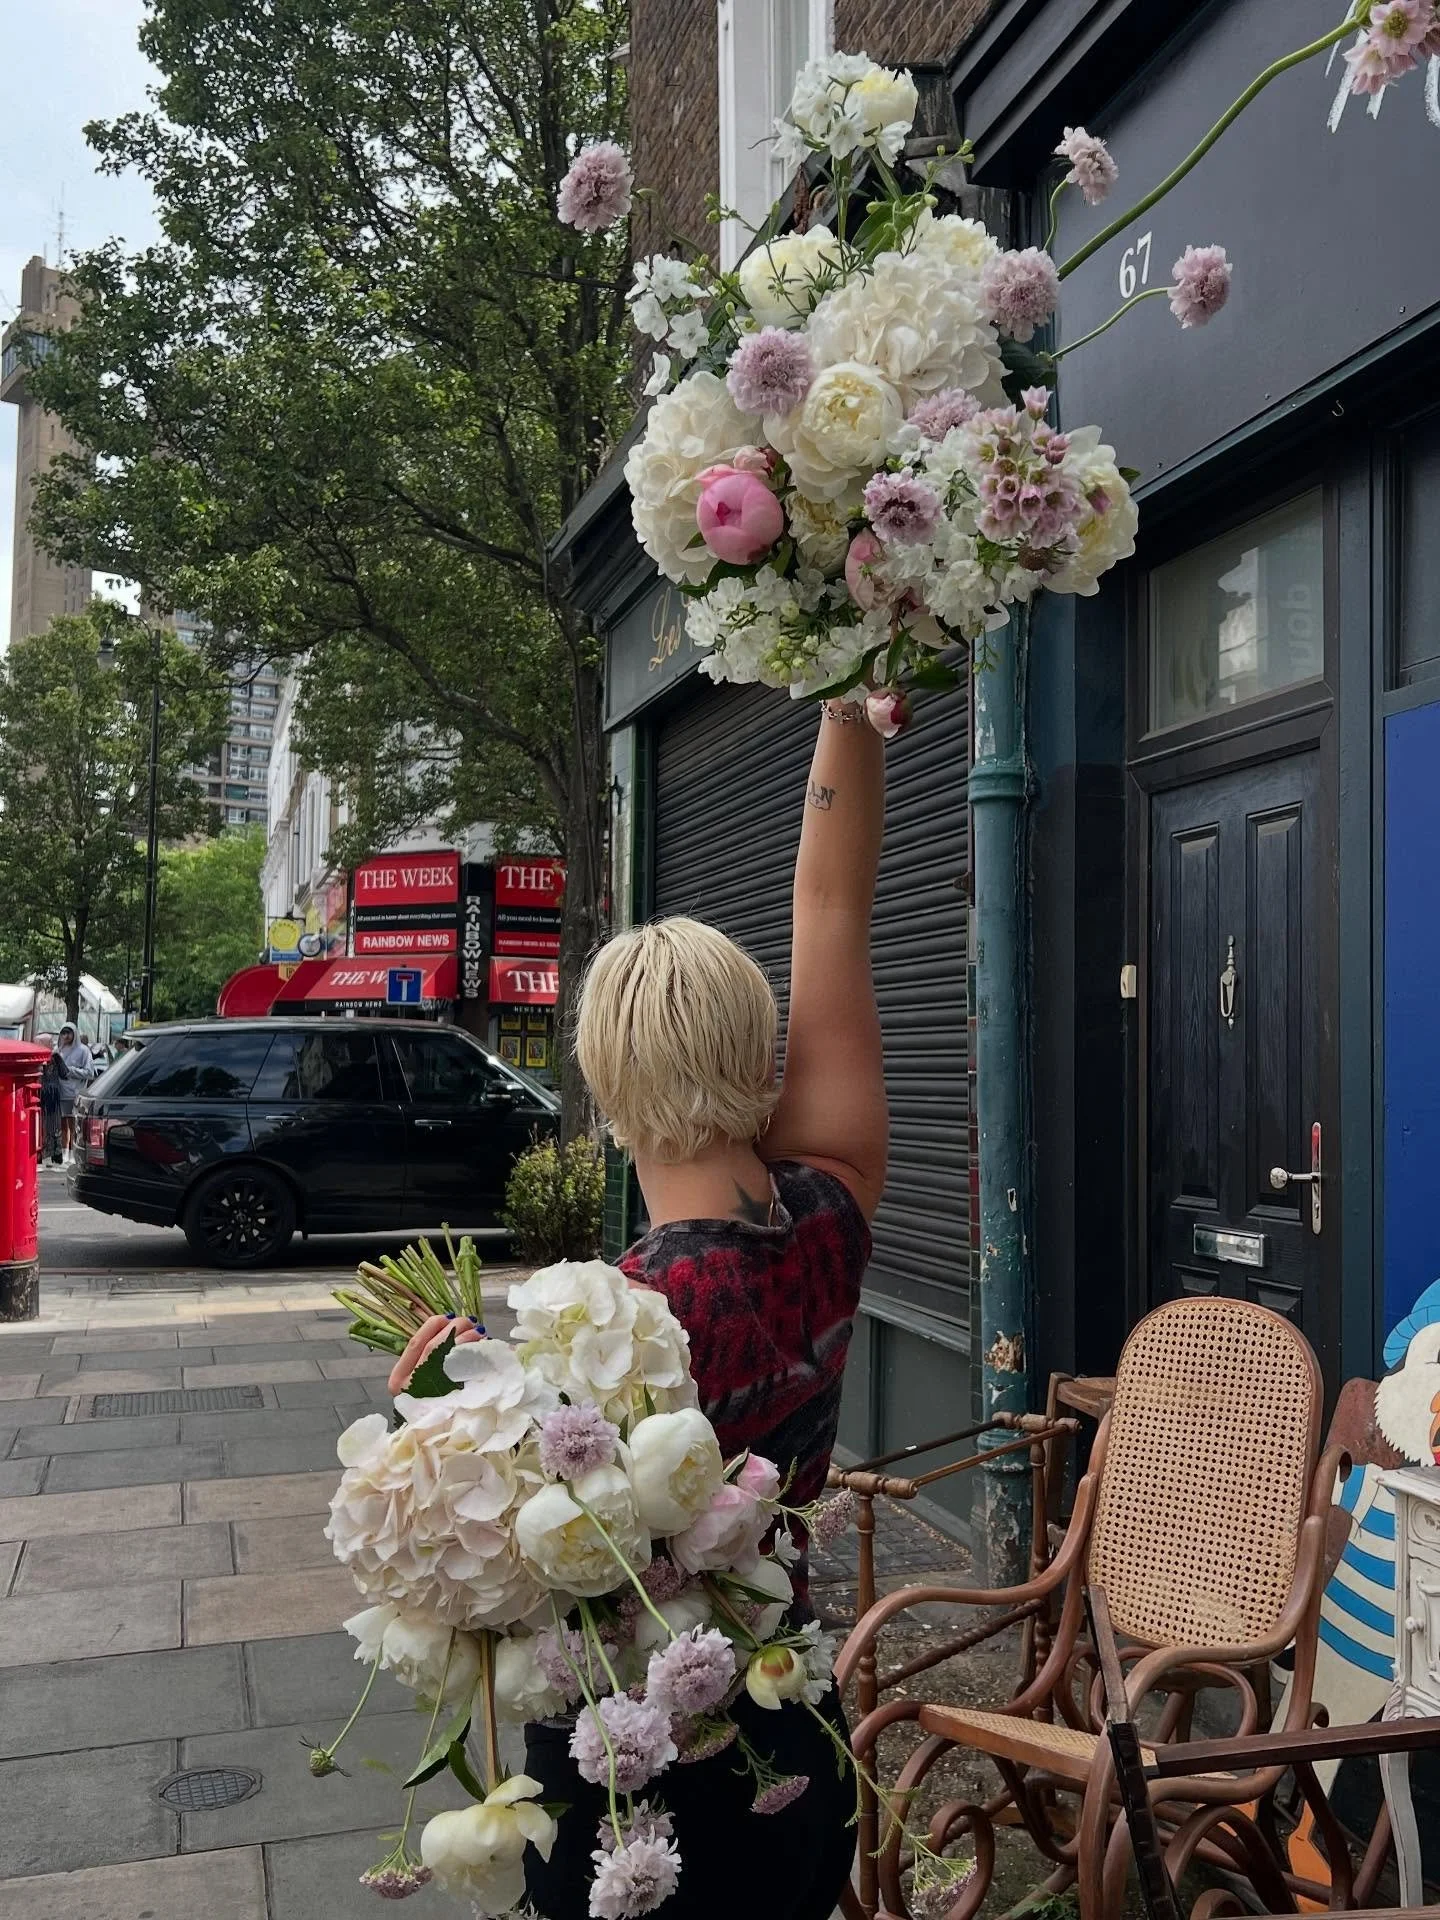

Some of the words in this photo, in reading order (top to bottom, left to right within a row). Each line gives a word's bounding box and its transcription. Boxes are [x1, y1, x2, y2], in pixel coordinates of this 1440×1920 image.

[1119, 231, 1152, 298] 67
[360, 868, 397, 889] THE
[400, 866, 454, 888] WEEK
[500, 865, 555, 890] THE
[363, 935, 414, 949] RAINBOW
[417, 934, 450, 948] NEWS
[330, 970, 369, 986] THE
[507, 970, 559, 993] THE
[365, 1000, 382, 1008] NEWS
